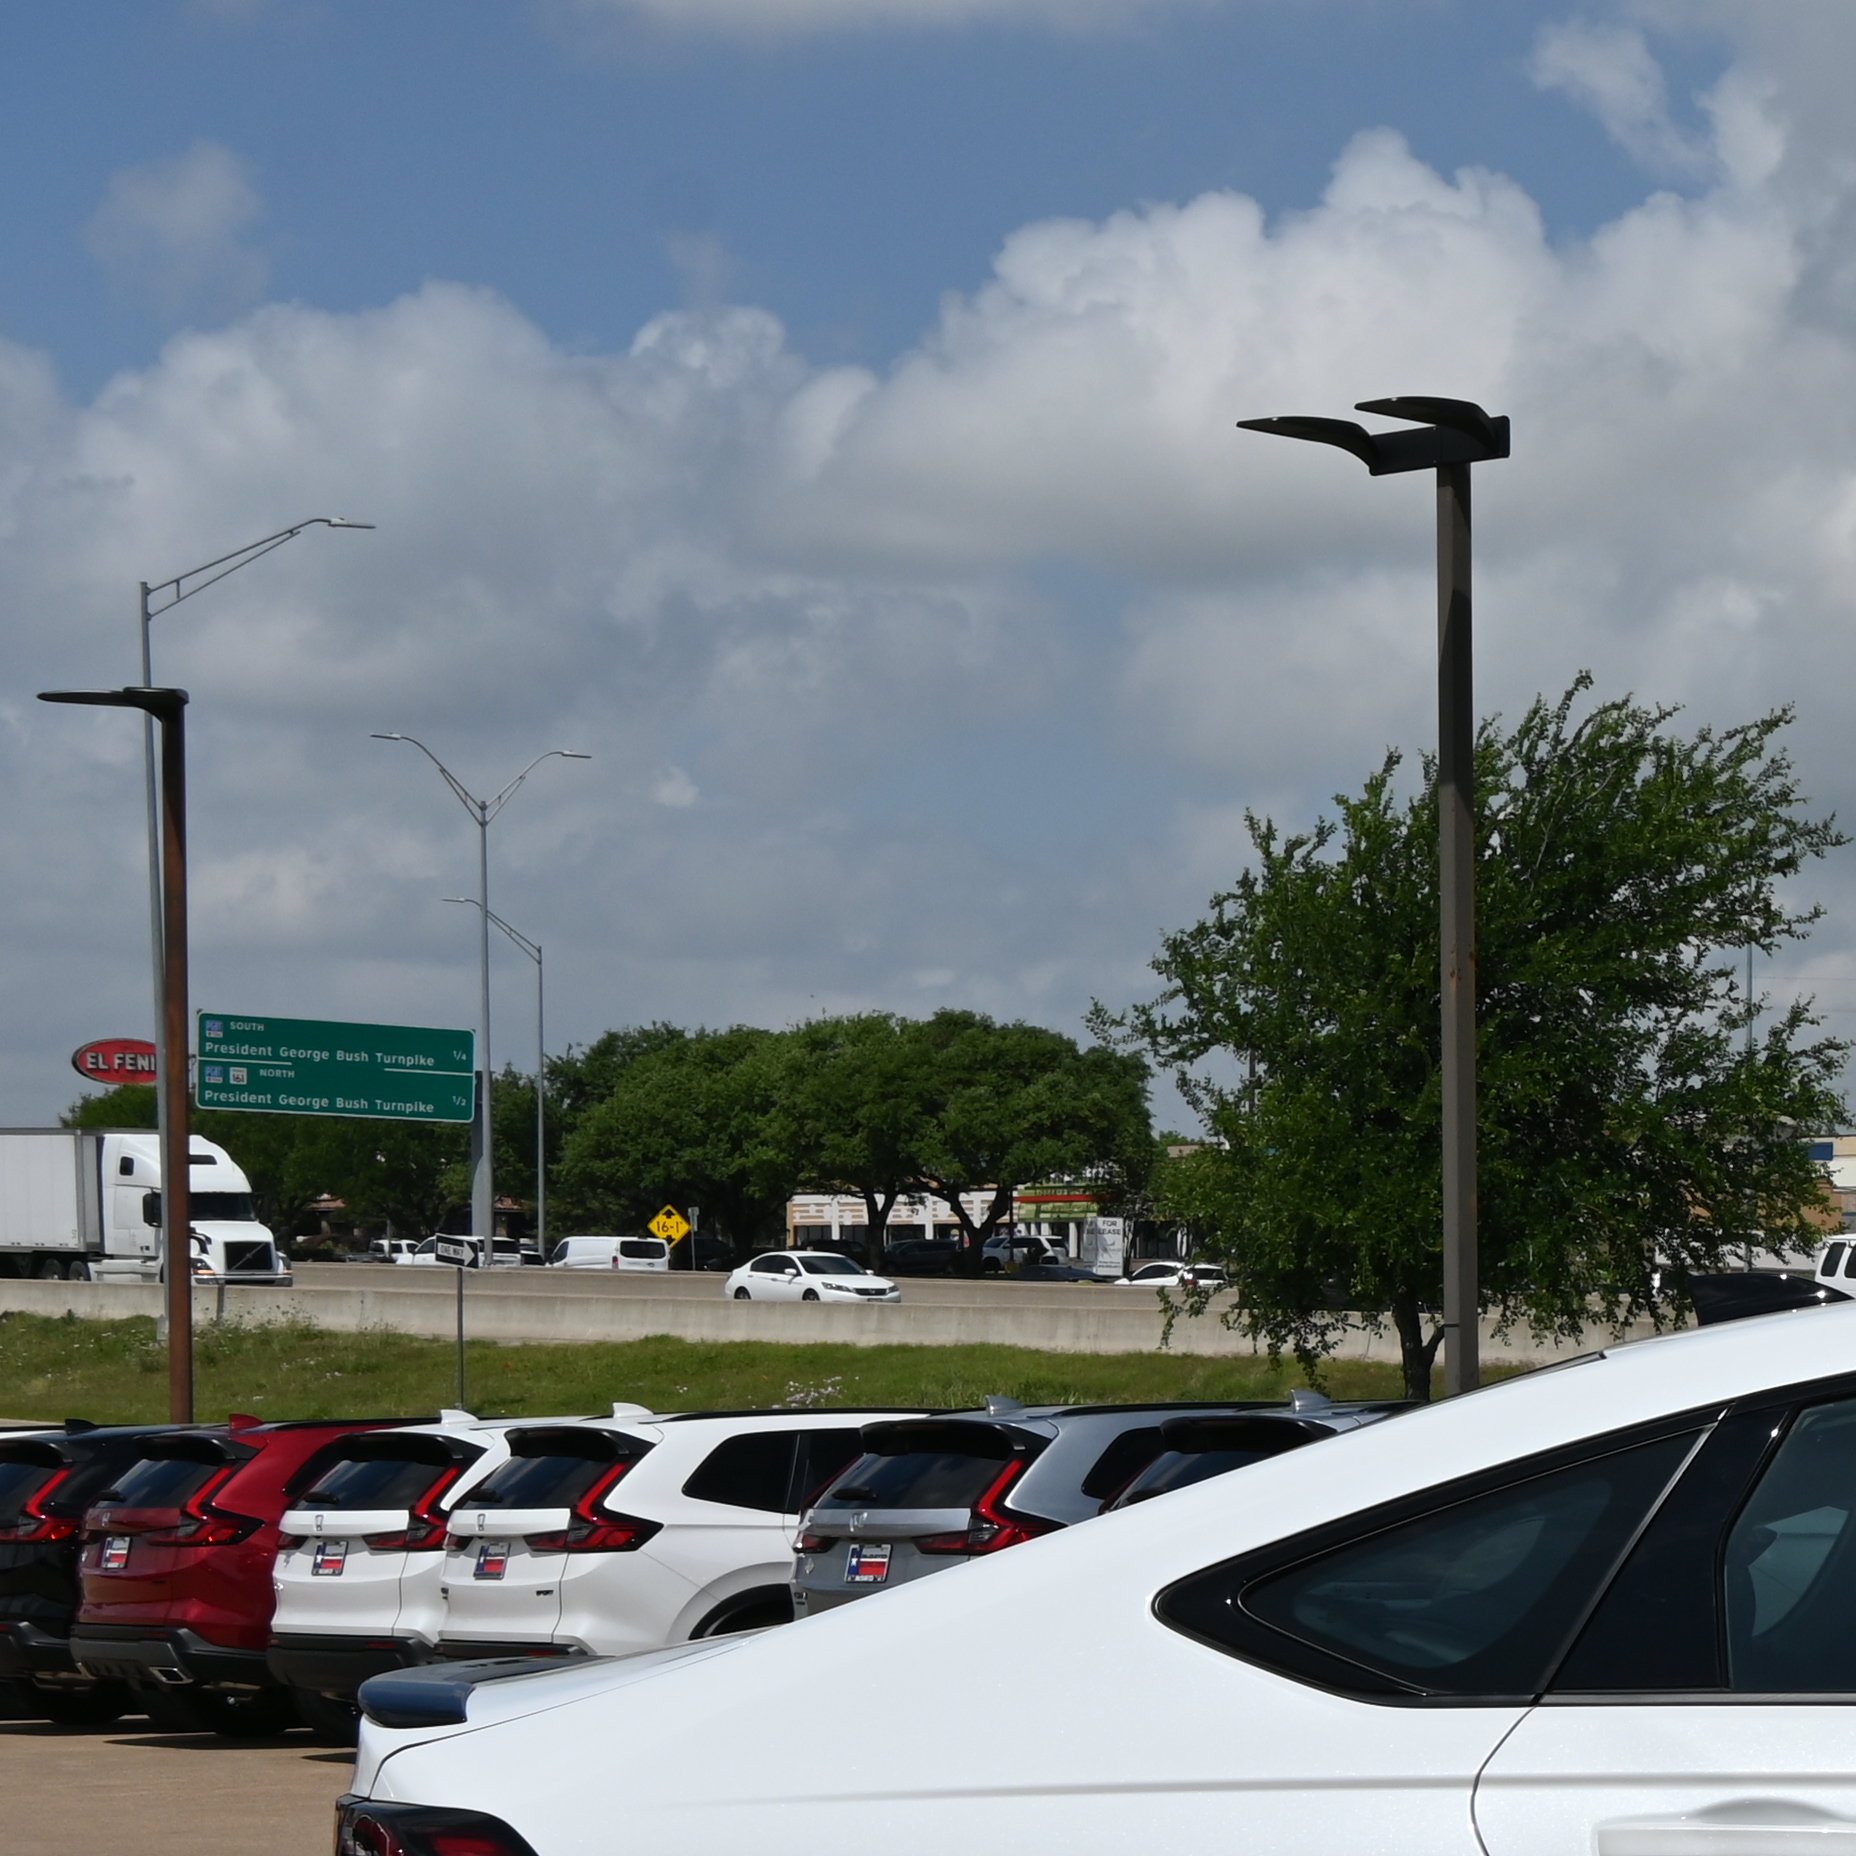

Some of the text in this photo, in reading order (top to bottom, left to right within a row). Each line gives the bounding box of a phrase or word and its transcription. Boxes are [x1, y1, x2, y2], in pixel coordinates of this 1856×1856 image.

[229, 1021, 265, 1032] SOUTH
[86, 1052, 109, 1070] EL
[205, 1042, 273, 1057] President
[279, 1046, 330, 1062] George
[336, 1050, 369, 1062] Bush
[376, 1052, 435, 1067] Turnpike
[259, 1068, 295, 1079] NORTH
[204, 1090, 272, 1104] President
[278, 1094, 329, 1109] George
[336, 1097, 368, 1109] Bush
[375, 1099, 434, 1115] Turnpike
